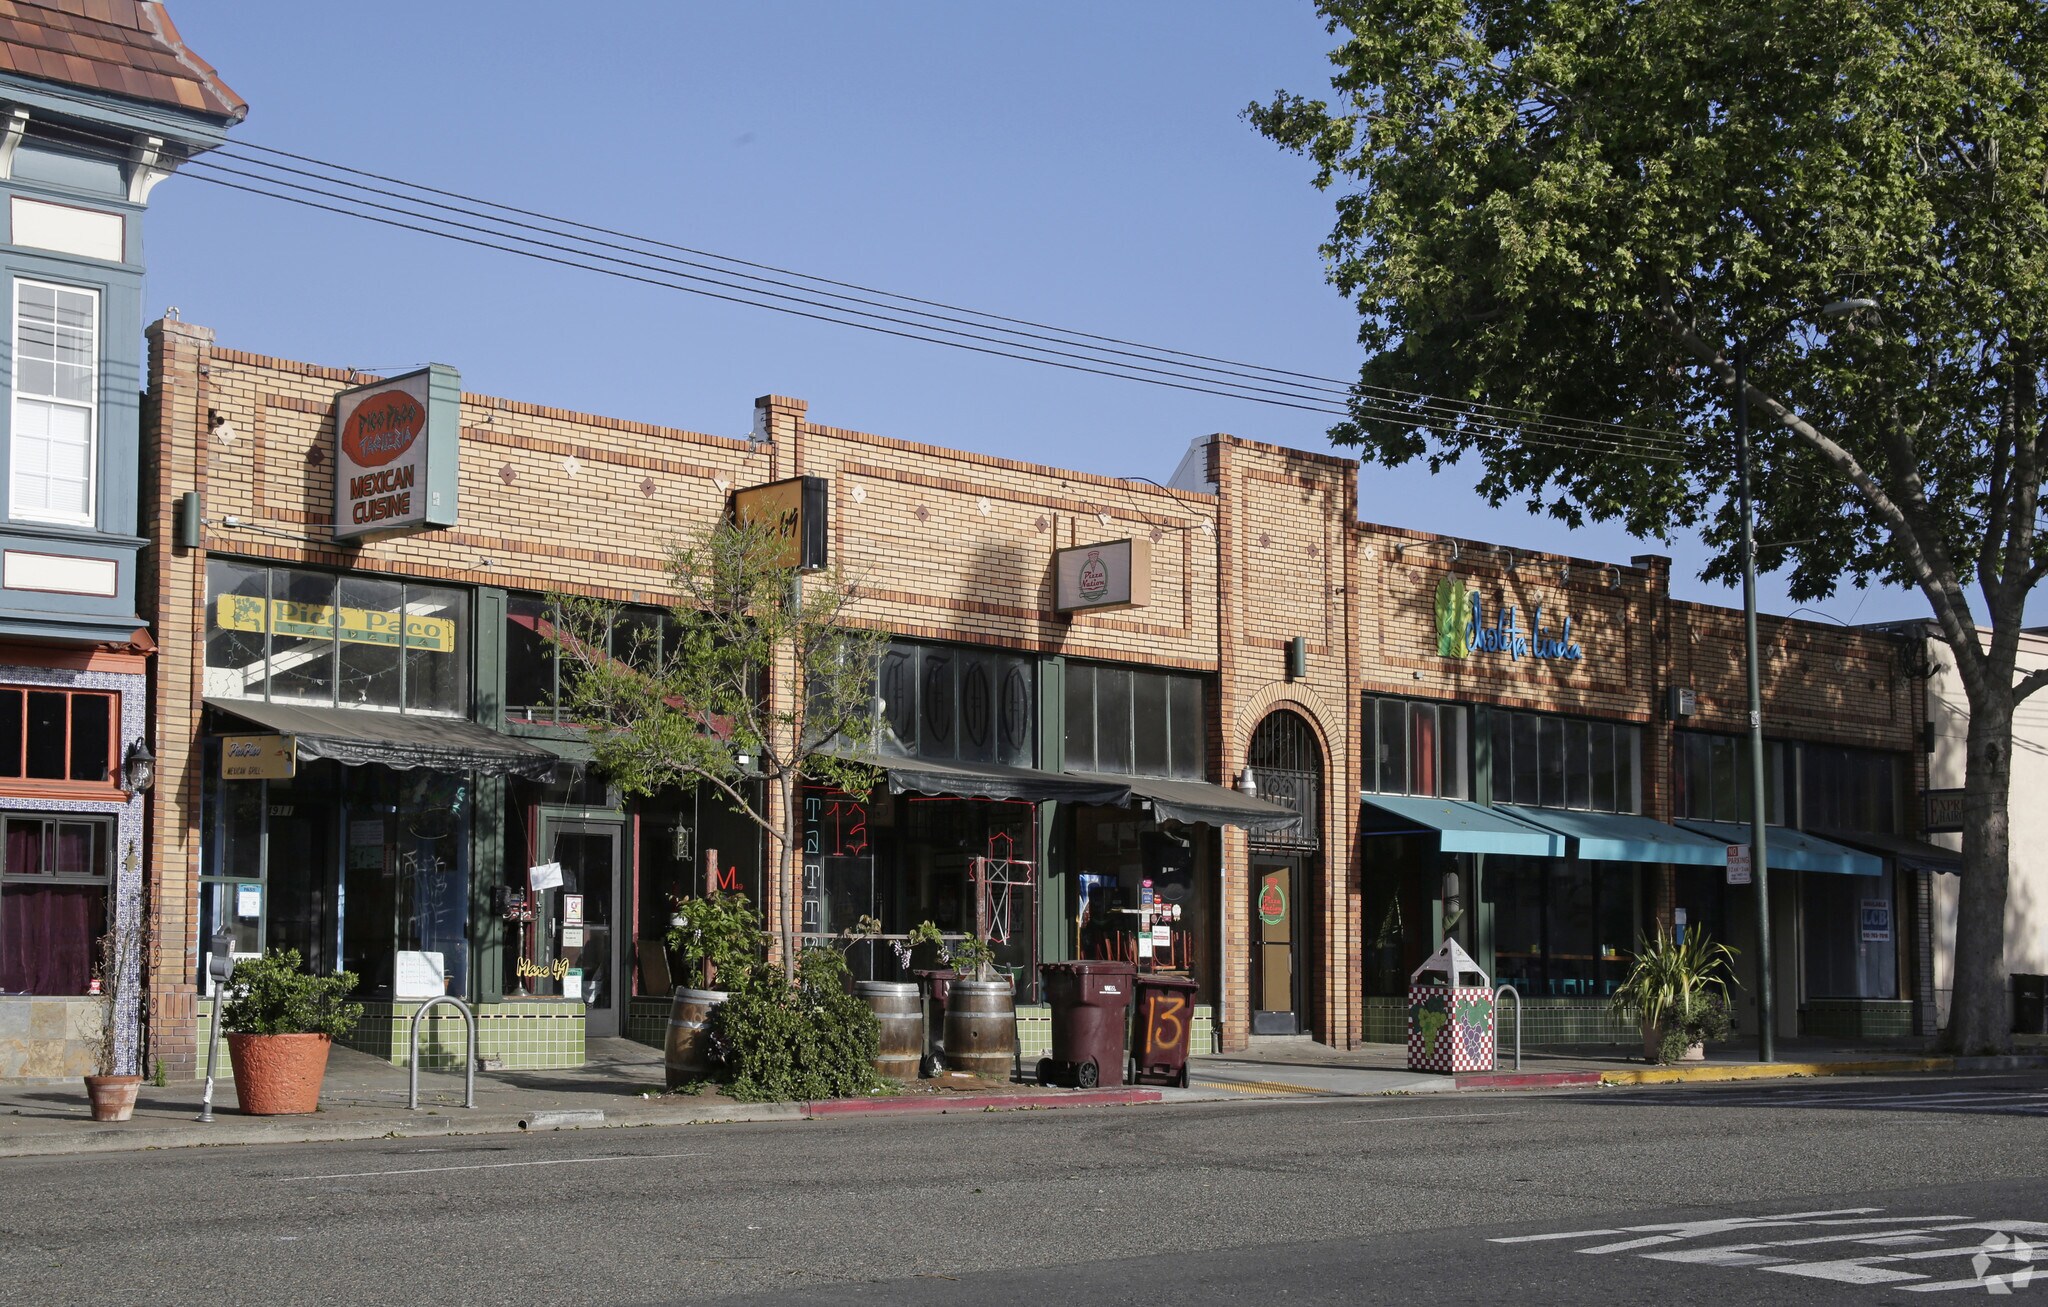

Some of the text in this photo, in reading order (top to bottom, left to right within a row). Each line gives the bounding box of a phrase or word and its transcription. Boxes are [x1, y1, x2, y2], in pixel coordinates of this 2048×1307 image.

[350, 464, 415, 500] MEXICAN
[353, 491, 411, 524] CUISINE
[1081, 578, 1105, 588] Nation
[1084, 571, 1103, 580] Pizza
[275, 601, 441, 638] Pico Paco
[227, 766, 261, 776] MEXICAN GRILL
[826, 802, 868, 856] 13
[1728, 847, 1737, 856] NO
[1728, 856, 1750, 865] PARKING
[1863, 910, 1887, 926] LCB
[517, 957, 570, 981] Marc 49
[1145, 995, 1186, 1054] 13
